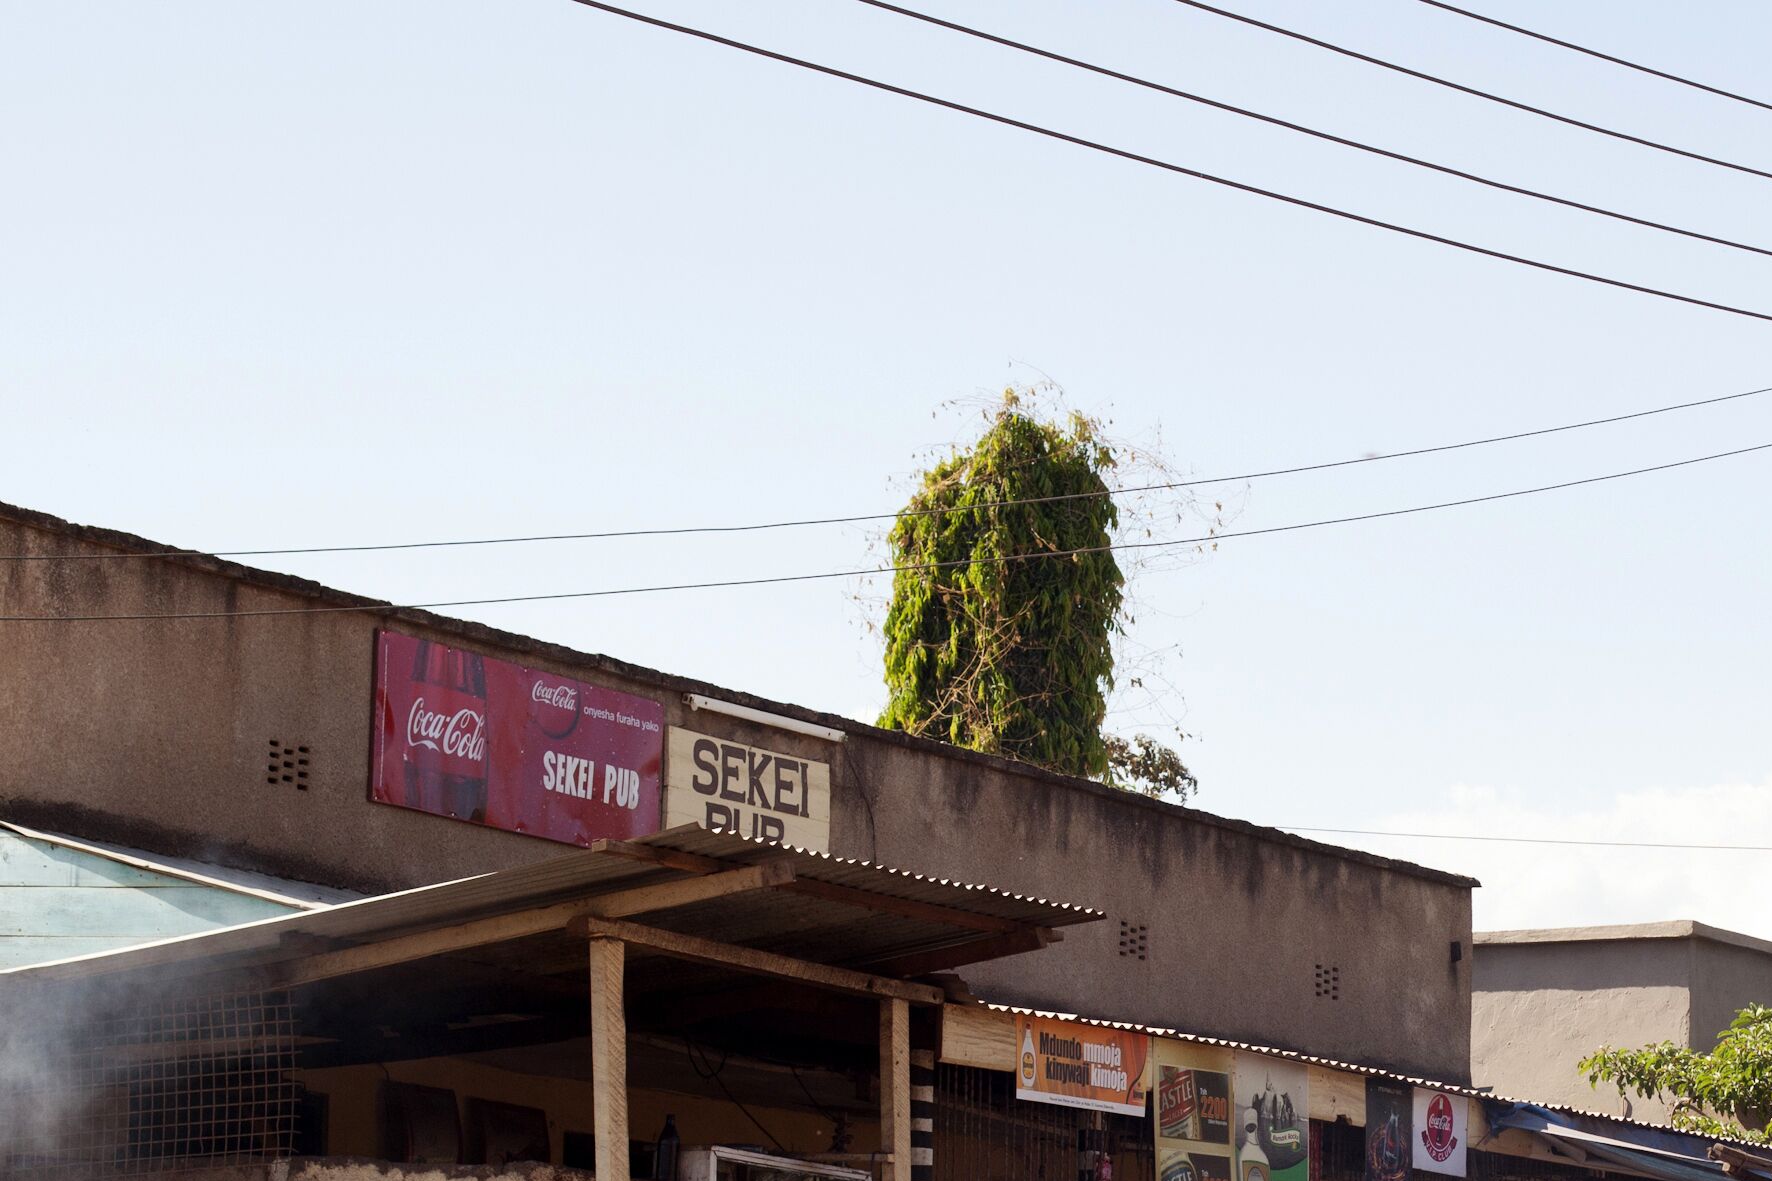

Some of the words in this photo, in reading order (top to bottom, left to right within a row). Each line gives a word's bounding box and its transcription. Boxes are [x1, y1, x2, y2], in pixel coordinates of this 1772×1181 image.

[532, 680, 577, 711] Coca-Cola
[408, 697, 485, 761] Coca-Cola
[583, 706, 615, 721] onyesha
[616, 712, 640, 728] furaha
[641, 719, 660, 732] yako
[543, 750, 594, 800] SEKEI
[603, 764, 640, 810] PUB
[692, 739, 810, 818] SEKEI
[1039, 1031, 1081, 1061] Mdundo
[1083, 1043, 1121, 1067] mmoja
[1045, 1057, 1089, 1087] kinywaji
[1090, 1063, 1128, 1092] kimoja
[1200, 1095, 1227, 1120] 2200
[1429, 1113, 1451, 1131] Coca-Cola
